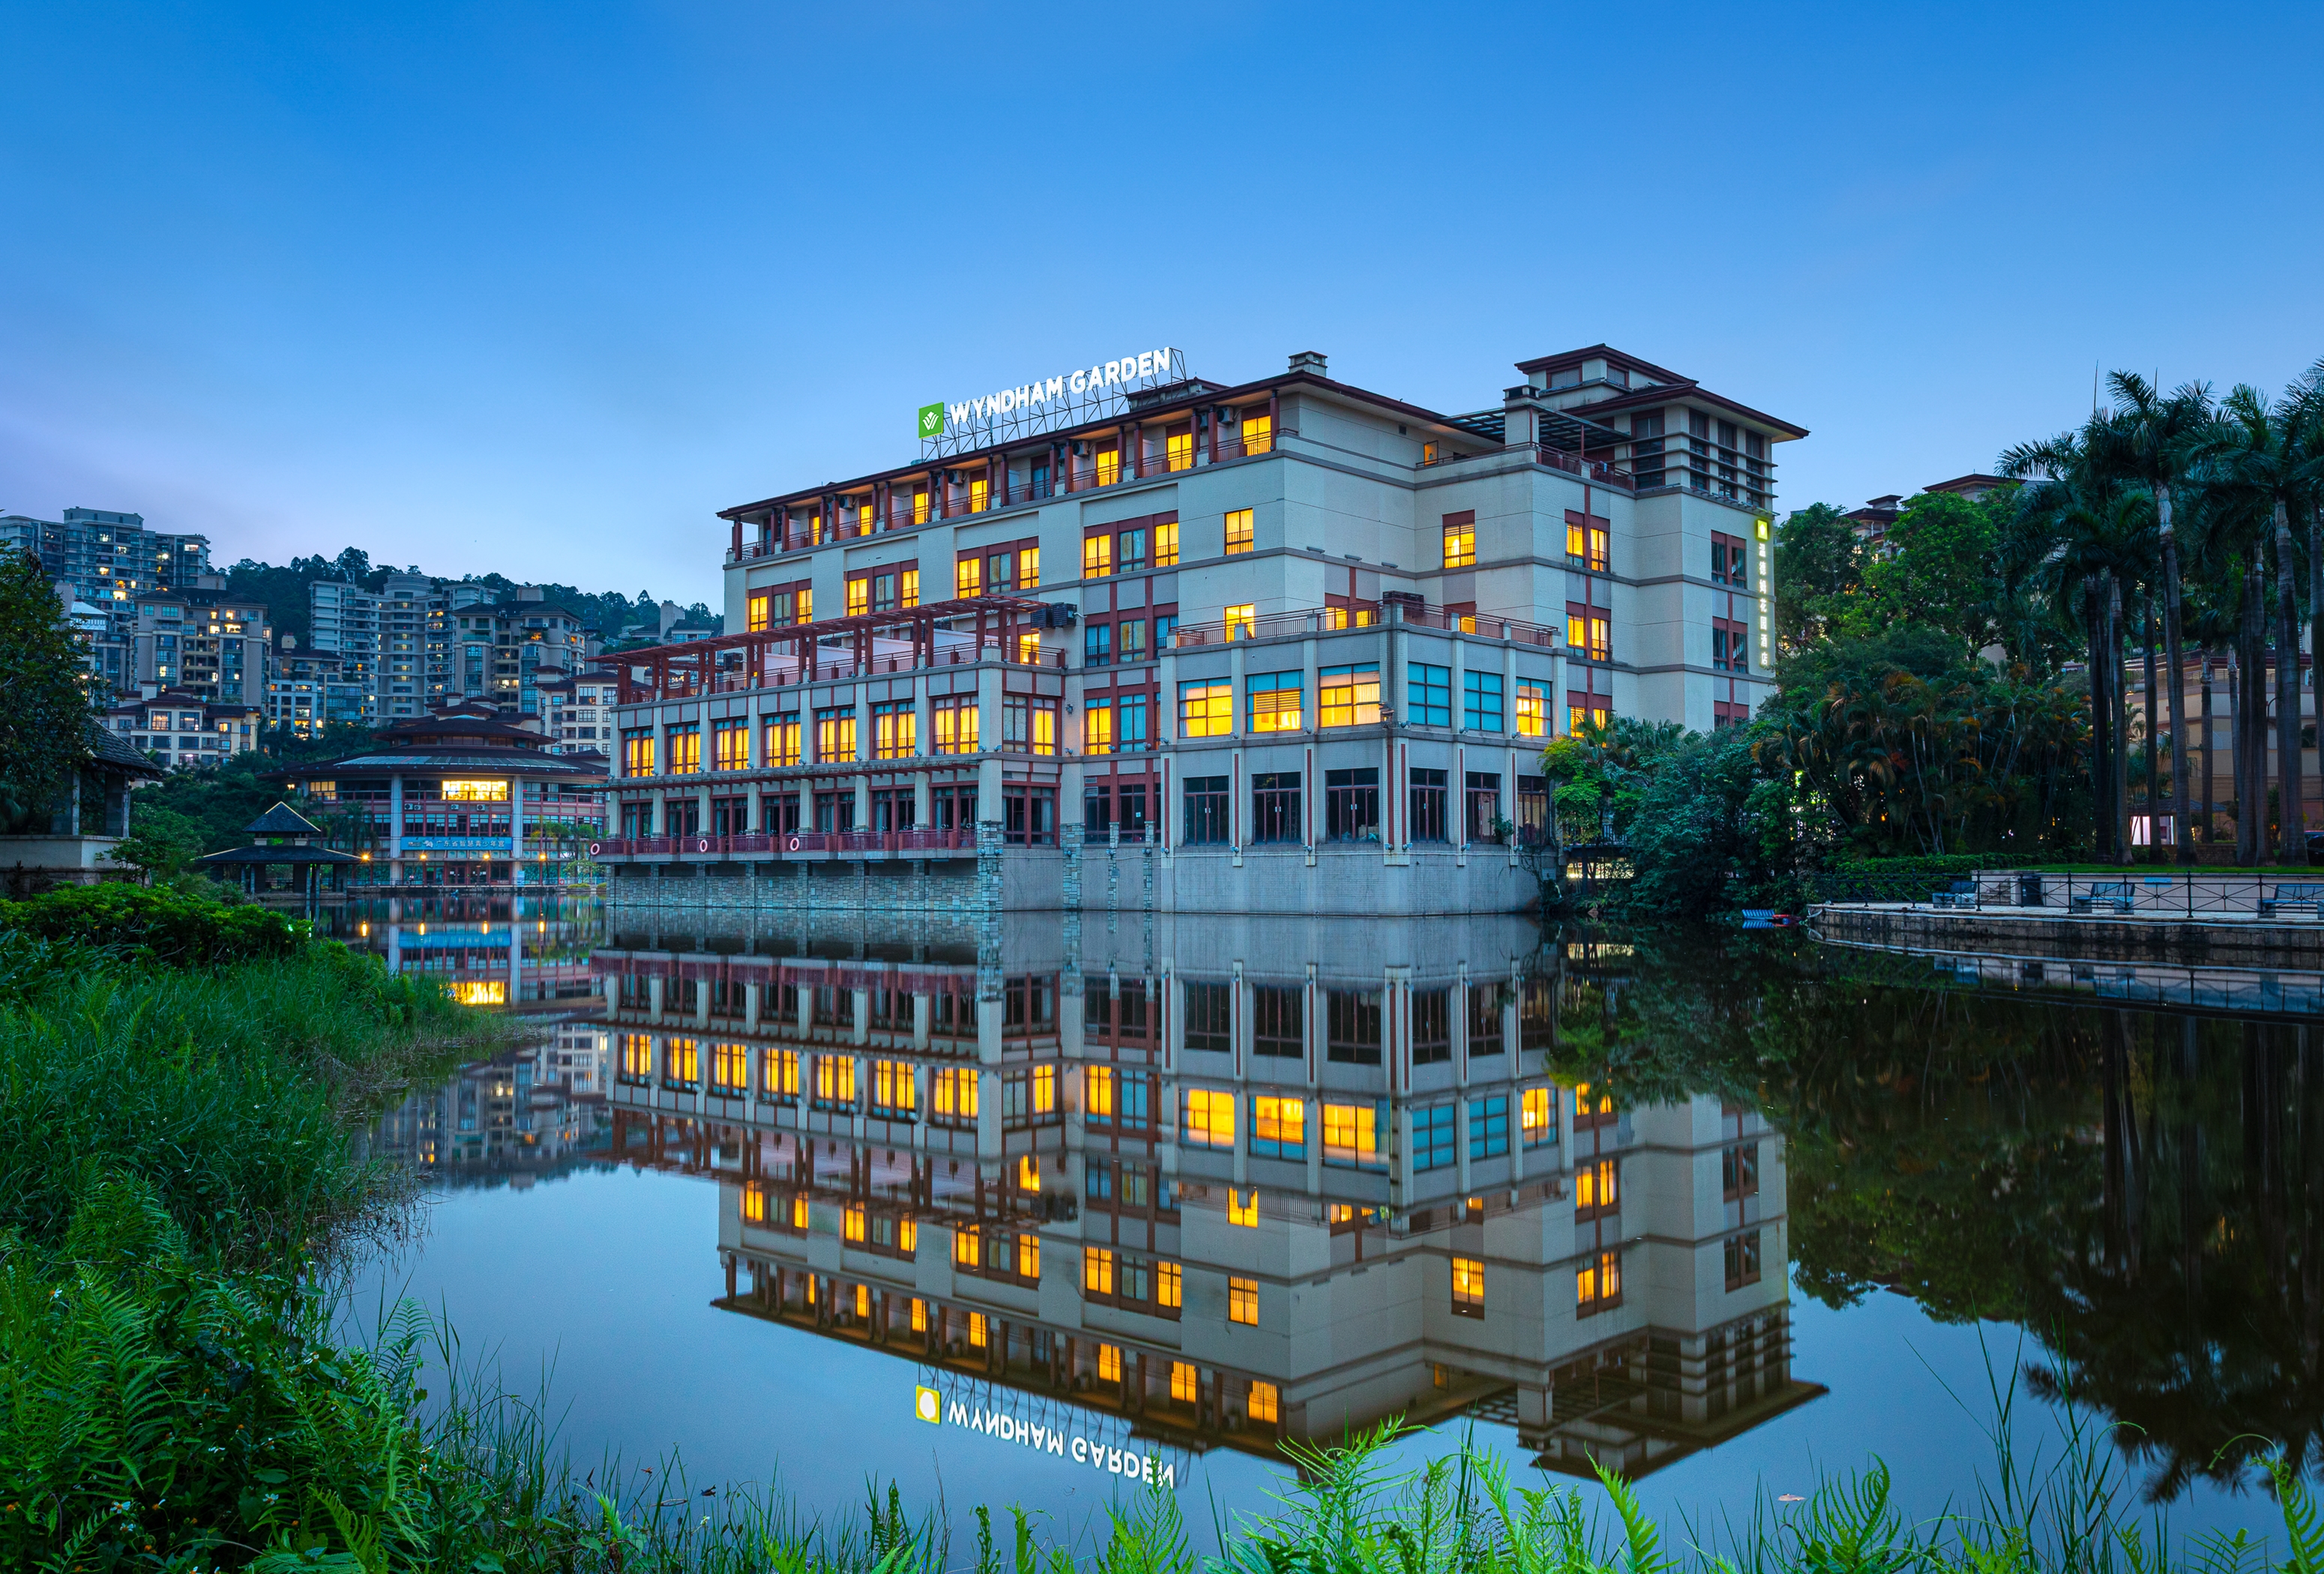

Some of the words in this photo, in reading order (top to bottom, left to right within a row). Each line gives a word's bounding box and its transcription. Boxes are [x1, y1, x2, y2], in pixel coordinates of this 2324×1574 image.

[949, 375, 1063, 425] WYNDHAM
[1069, 346, 1170, 394] GARDEN
[1758, 543, 1768, 666] 温德姆花园酒店
